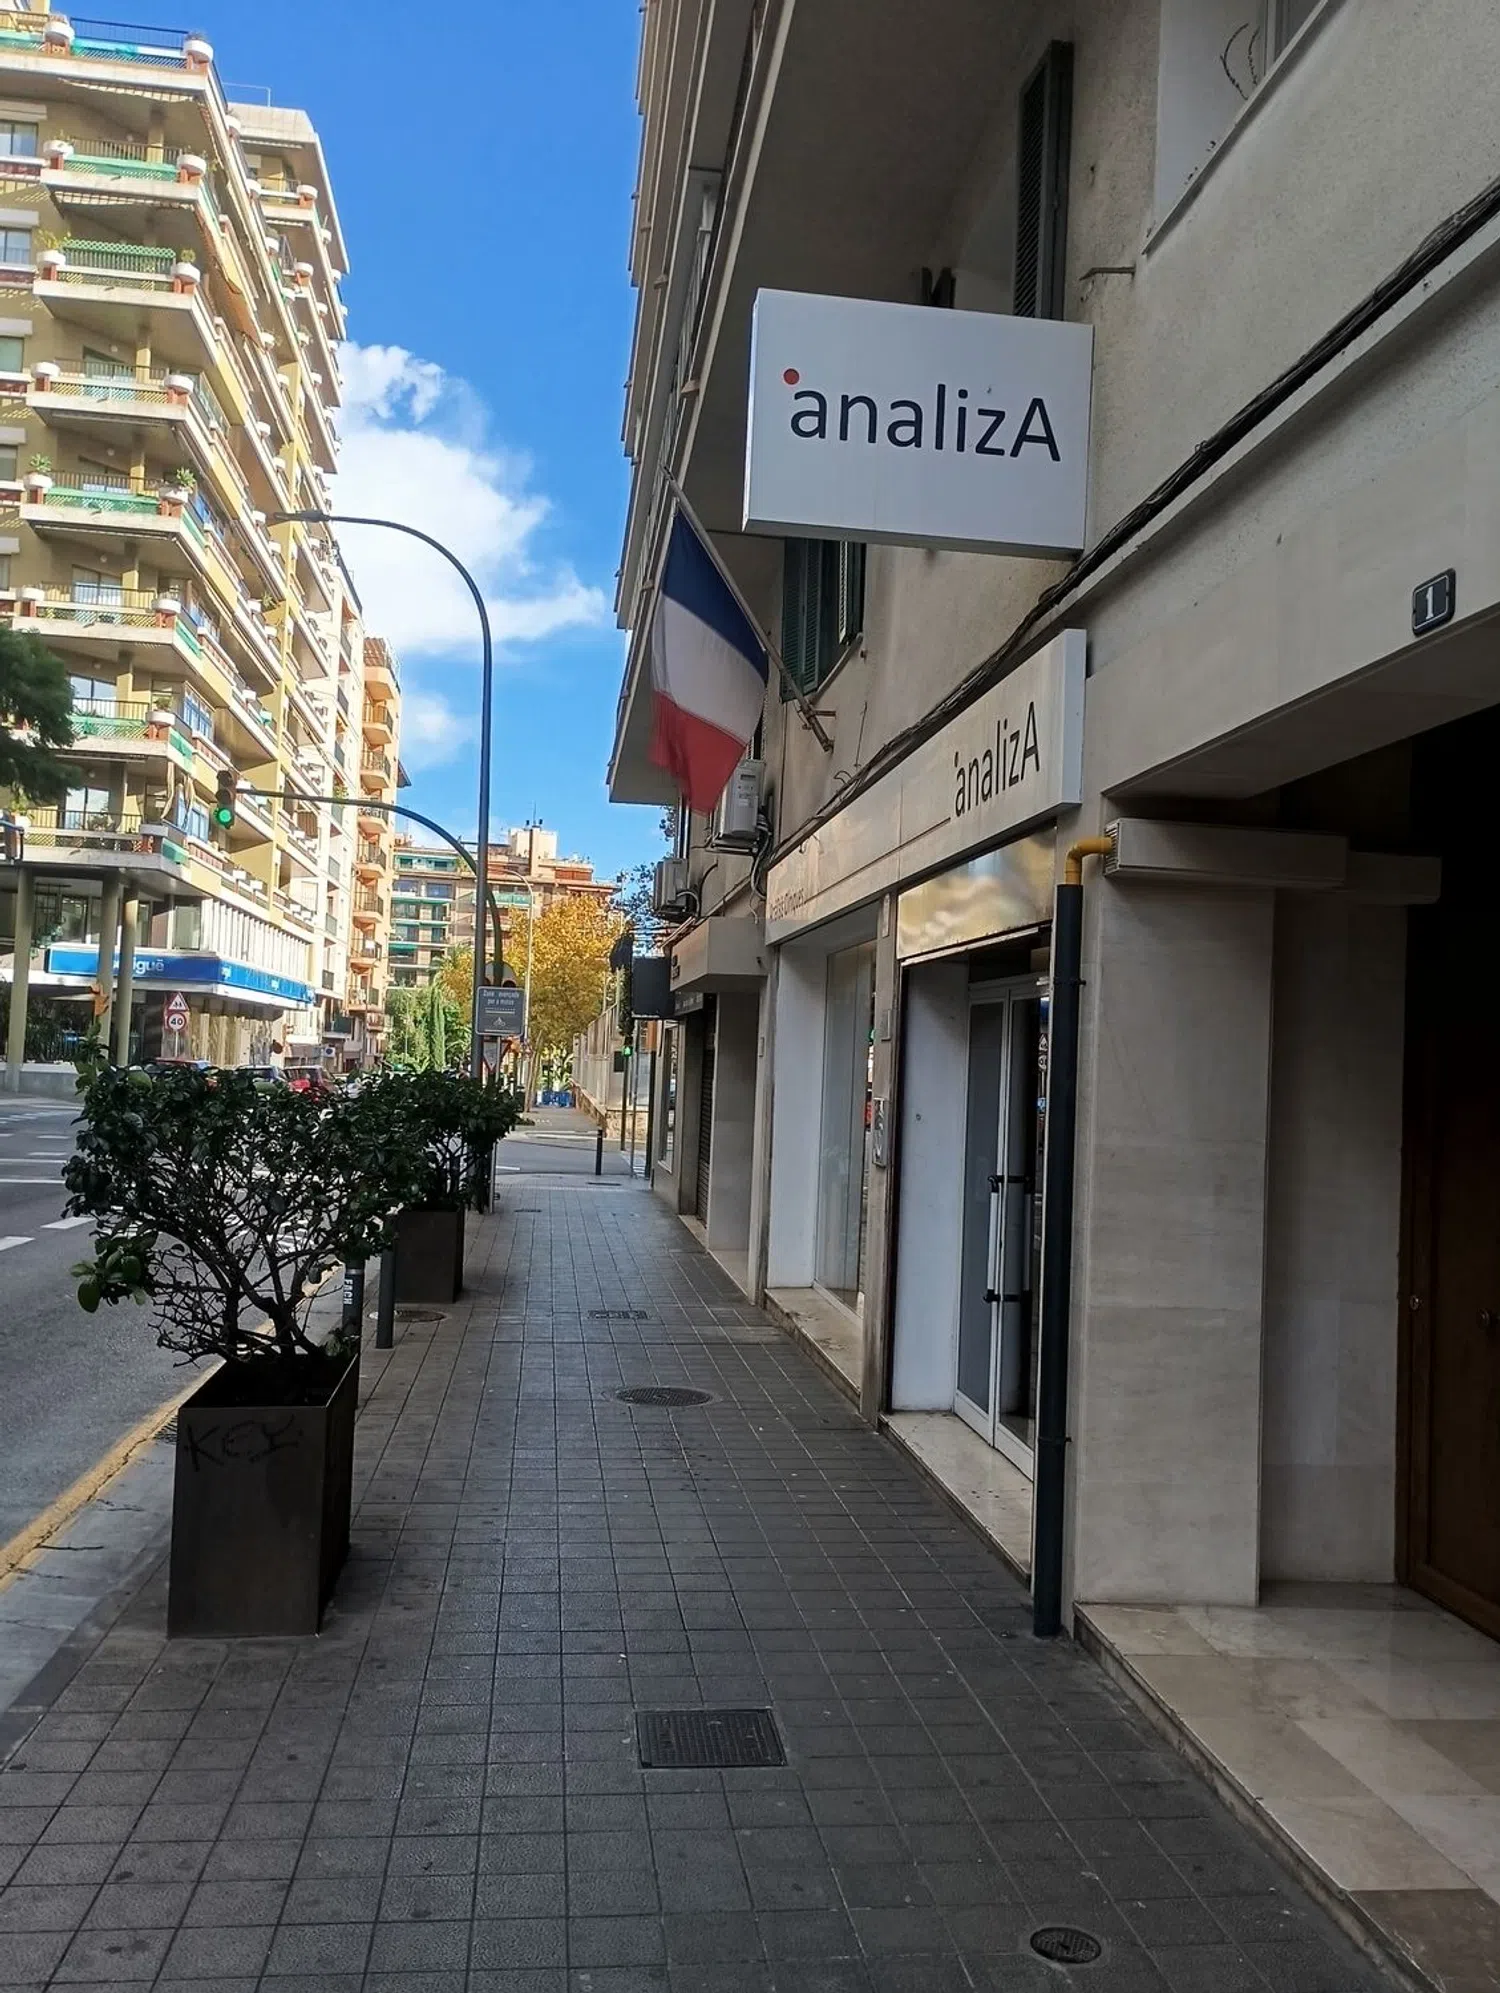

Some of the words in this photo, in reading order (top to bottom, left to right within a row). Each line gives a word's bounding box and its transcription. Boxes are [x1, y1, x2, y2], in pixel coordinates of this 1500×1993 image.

[784, 368, 1060, 462] analizA
[1425, 585, 1434, 620] 1
[954, 701, 1040, 817] analizA
[170, 1017, 183, 1026] 40
